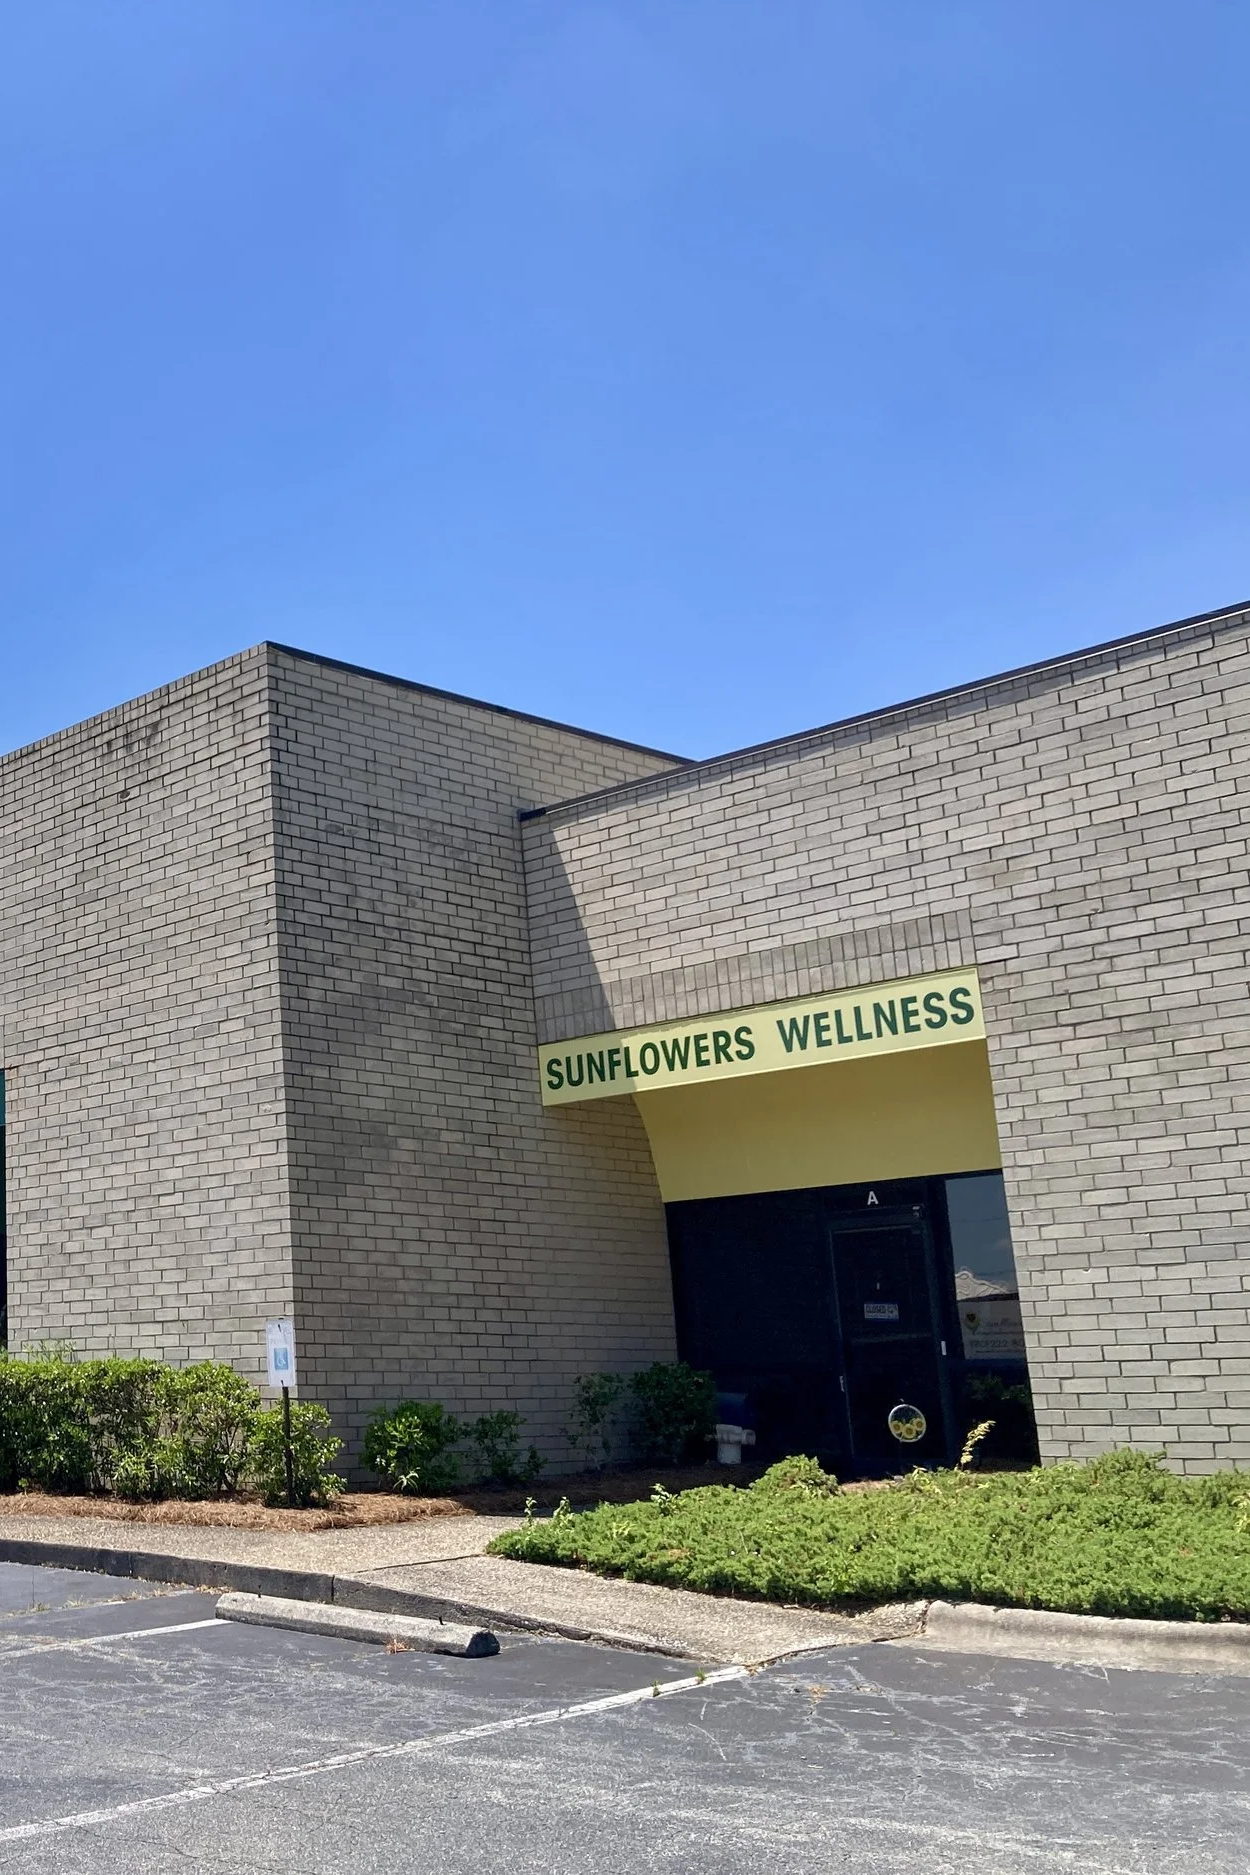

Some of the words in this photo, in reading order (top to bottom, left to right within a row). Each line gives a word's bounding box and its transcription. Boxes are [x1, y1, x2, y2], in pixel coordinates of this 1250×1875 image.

[547, 1025, 756, 1090] SUNFLOWERS
[776, 986, 975, 1053] WELLNESS
[867, 1190, 879, 1205] A
